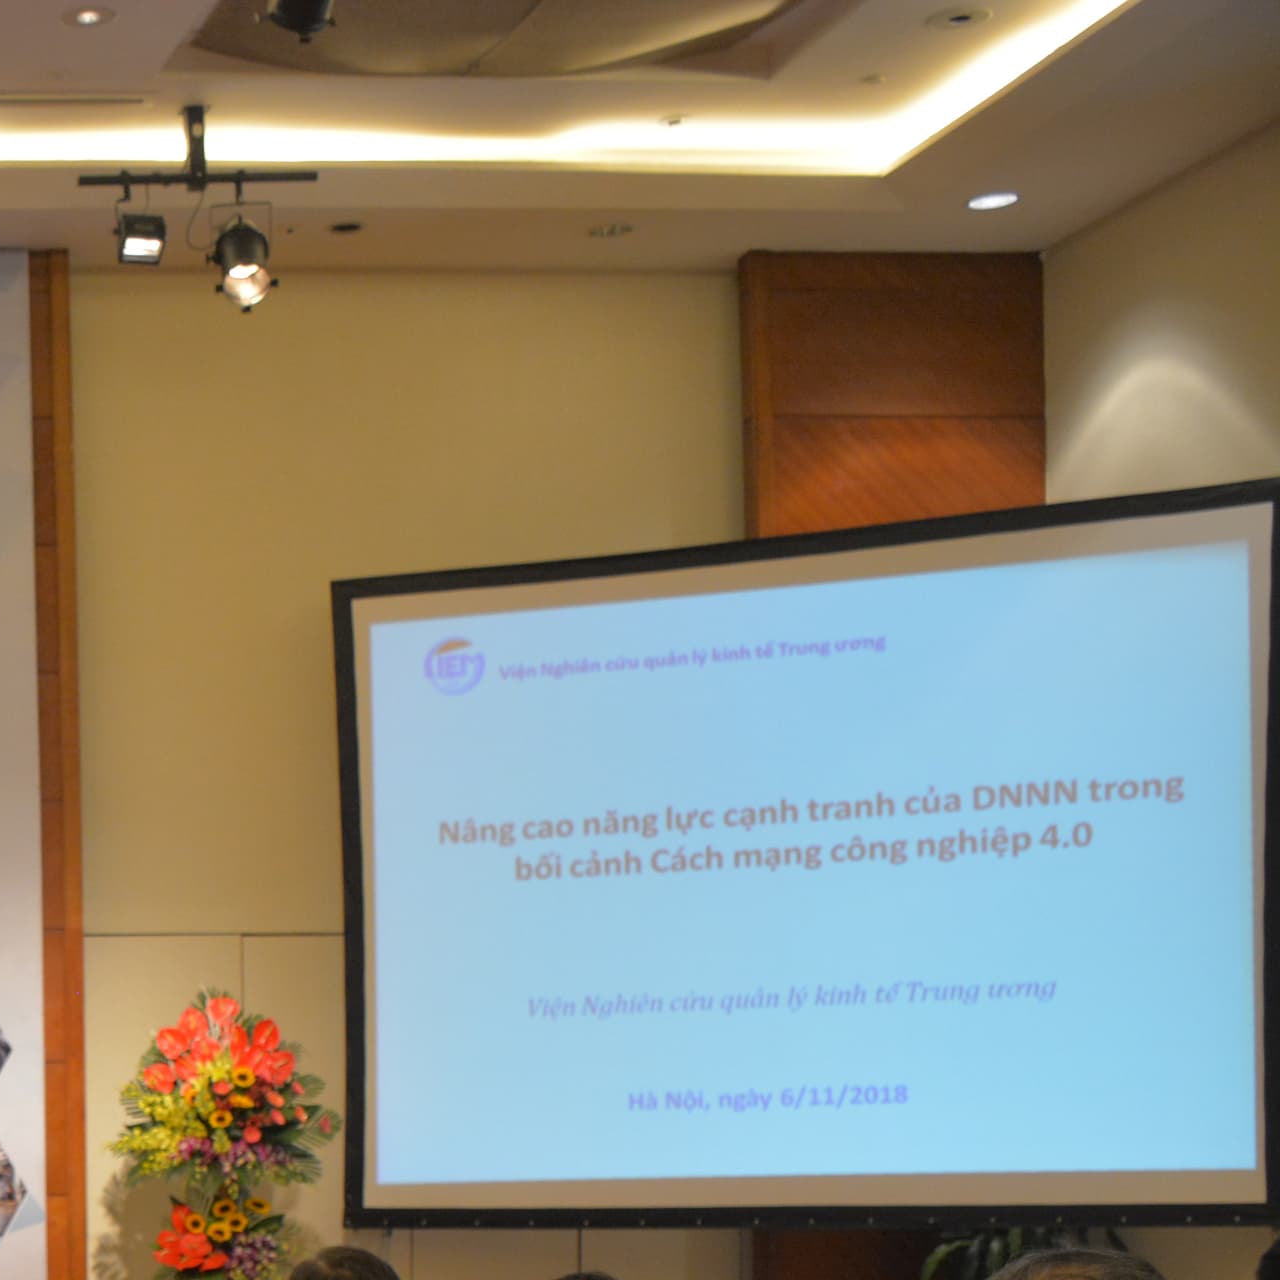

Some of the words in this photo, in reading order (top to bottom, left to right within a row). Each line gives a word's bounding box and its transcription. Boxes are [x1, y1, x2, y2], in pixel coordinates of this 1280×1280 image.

[438, 817, 516, 848] Nâng
[522, 818, 574, 841] cao
[583, 809, 659, 838] năng
[665, 805, 715, 835] lực
[723, 798, 800, 832] cạnh
[807, 791, 896, 823] tranh
[903, 784, 962, 816] của
[972, 778, 1079, 812] DNNN
[1088, 775, 1186, 805] trong
[514, 852, 563, 882] bối
[568, 849, 643, 879] cảnh
[650, 845, 724, 874] Cách
[733, 844, 823, 872] mạng
[830, 834, 909, 866] công
[916, 825, 1033, 863] nghiệp
[1039, 820, 1094, 850] 4.0
[814, 982, 868, 1007] kinh
[905, 980, 981, 1006] Trung
[628, 1089, 659, 1111] Hà
[665, 1088, 711, 1114] Nội,
[718, 1087, 774, 1112] ngày
[779, 1083, 910, 1110] 6/11/2018
